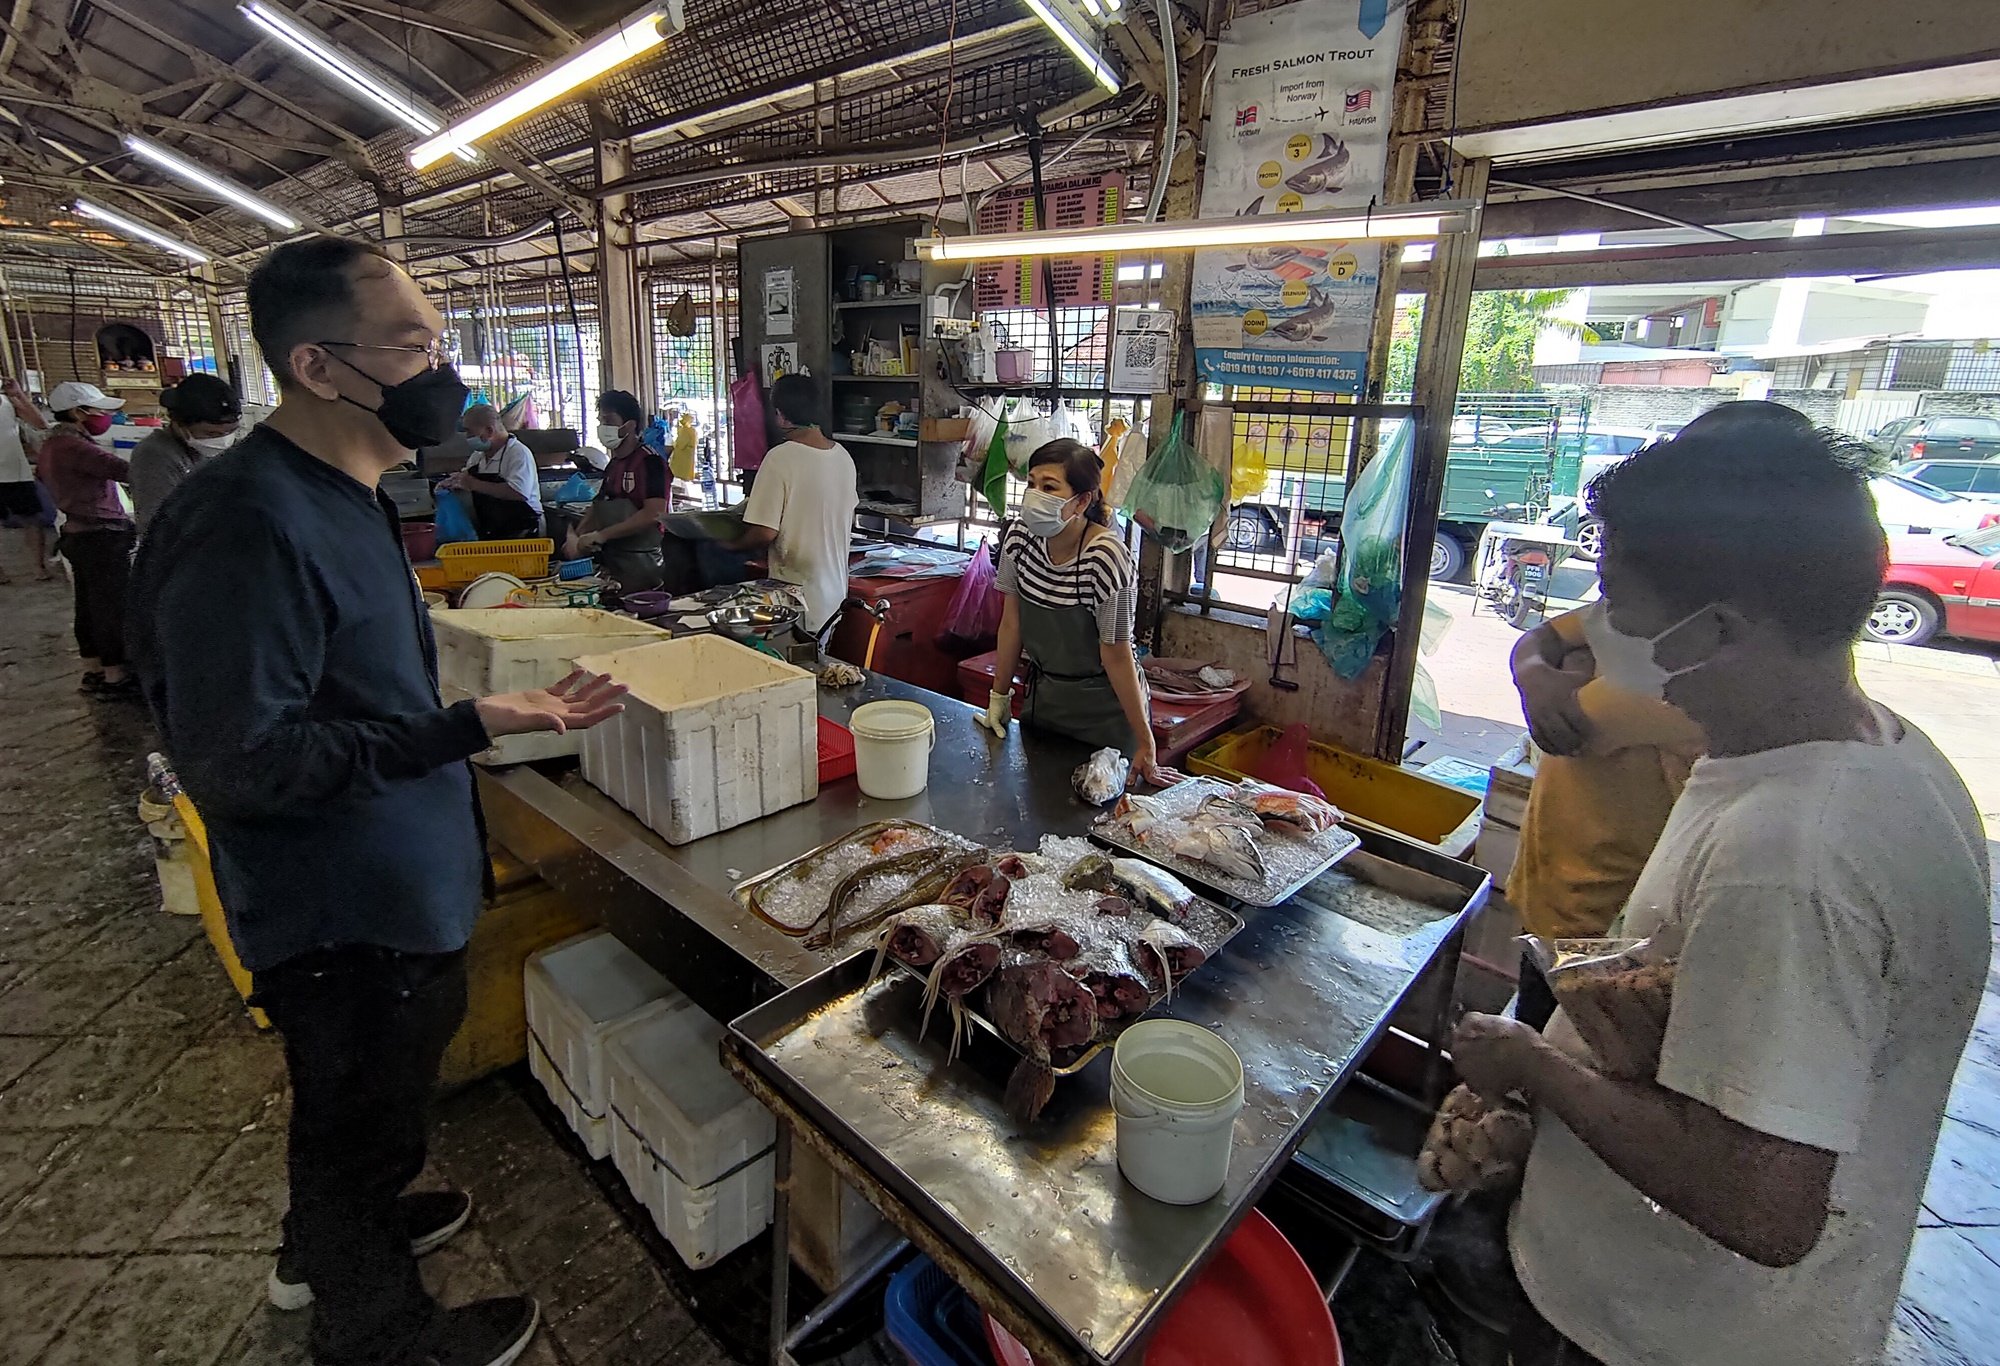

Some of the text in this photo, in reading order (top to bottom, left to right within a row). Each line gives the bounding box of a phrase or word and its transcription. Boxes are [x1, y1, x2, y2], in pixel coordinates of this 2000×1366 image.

[1232, 49, 1374, 78] FRESH SALMON TROUT
[1280, 80, 1325, 93] Import from
[1287, 92, 1317, 103] Norway
[1293, 149, 1300, 158] 3
[1338, 267, 1345, 275] D
[1224, 350, 1250, 362] Enquiry
[1252, 353, 1263, 362] for
[1264, 354, 1286, 363] more
[1216, 362, 1357, 380] +6019 418 1430 / +6019 417 4375
